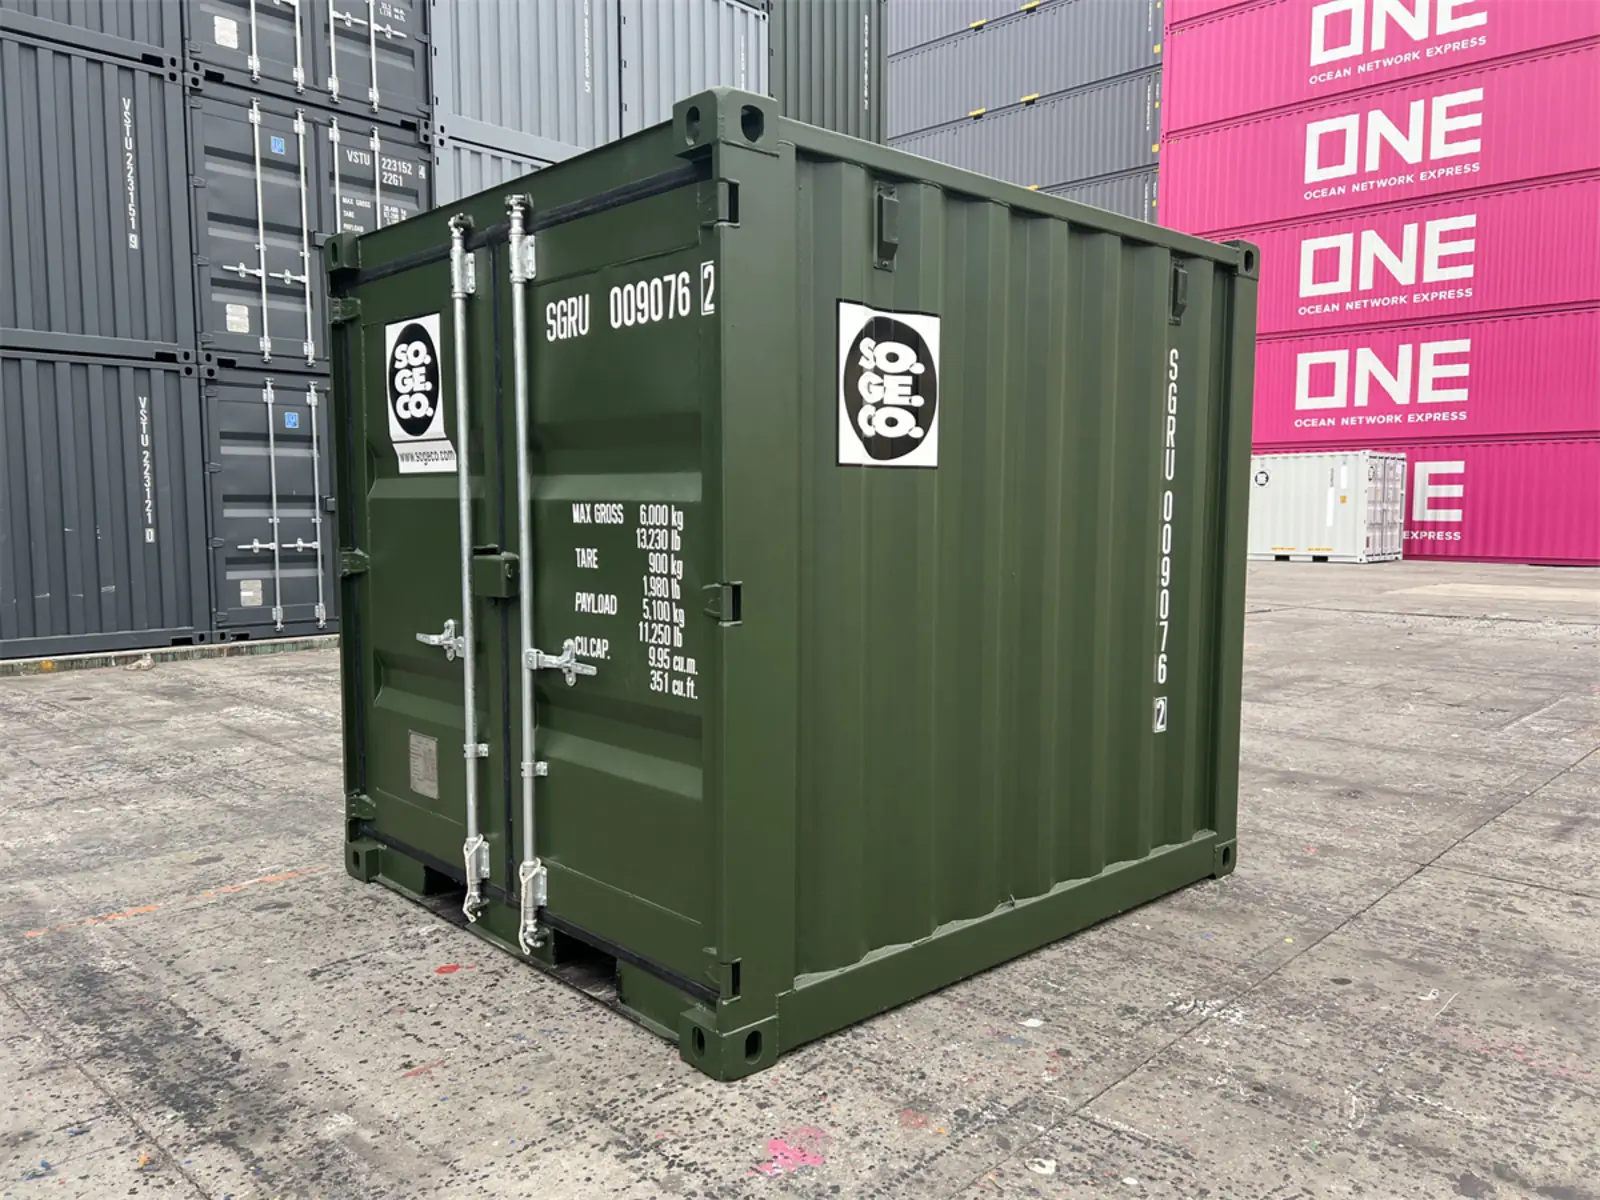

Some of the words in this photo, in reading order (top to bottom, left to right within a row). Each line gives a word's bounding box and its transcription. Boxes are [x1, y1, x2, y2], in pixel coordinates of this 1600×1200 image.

[1309, 67, 1352, 85] OCEAN
[1357, 51, 1420, 74] NETWORK
[1426, 35, 1487, 57] EXPRESS
[122, 97, 133, 150] VSTU
[1304, 88, 1484, 184] ONE
[346, 149, 371, 166] VSTU
[381, 157, 413, 176] 223152
[1303, 185, 1346, 200] OCEAN
[1351, 174, 1414, 193] NETWORK
[1419, 162, 1480, 181] EXPRESS
[126, 152, 136, 229] 223151
[1299, 214, 1477, 298] ONE
[546, 293, 590, 342] SGRU
[610, 271, 691, 329] 009076
[702, 263, 715, 313] 2
[1298, 303, 1340, 316] OCEAN
[1345, 295, 1408, 311] NETWORK
[1412, 287, 1473, 304] EXPRESS
[858, 336, 925, 375] SO.
[857, 370, 925, 407] GE.
[1295, 339, 1471, 411] ONE
[138, 396, 149, 447] VSTU
[857, 403, 925, 439] CO.
[1164, 348, 1179, 481] SGRU
[1294, 417, 1336, 428] OCEAN
[1341, 413, 1403, 426] NETWORK
[1407, 411, 1467, 423] EXPRESS
[399, 449, 455, 466] www.sogeco.com
[142, 450, 151, 525] 223121
[572, 503, 592, 524] MAX
[594, 503, 624, 524] GROSS
[671, 504, 684, 531] kg
[1403, 530, 1461, 541] EXPRESS
[671, 528, 681, 551] lb
[575, 547, 598, 569] TARE
[648, 551, 668, 574] 900
[670, 553, 683, 580] kg
[671, 577, 681, 599] lb
[1157, 490, 1173, 685] 009076
[575, 592, 617, 615] PAYLOAD
[672, 602, 685, 628] kg
[574, 635, 611, 660] CU.CAP.
[648, 645, 670, 670] 9.95
[673, 655, 698, 675] cu.m.
[673, 625, 682, 648] lb
[649, 669, 669, 693] 351
[671, 676, 698, 700] cu.ft.
[1155, 698, 1168, 732] 2
